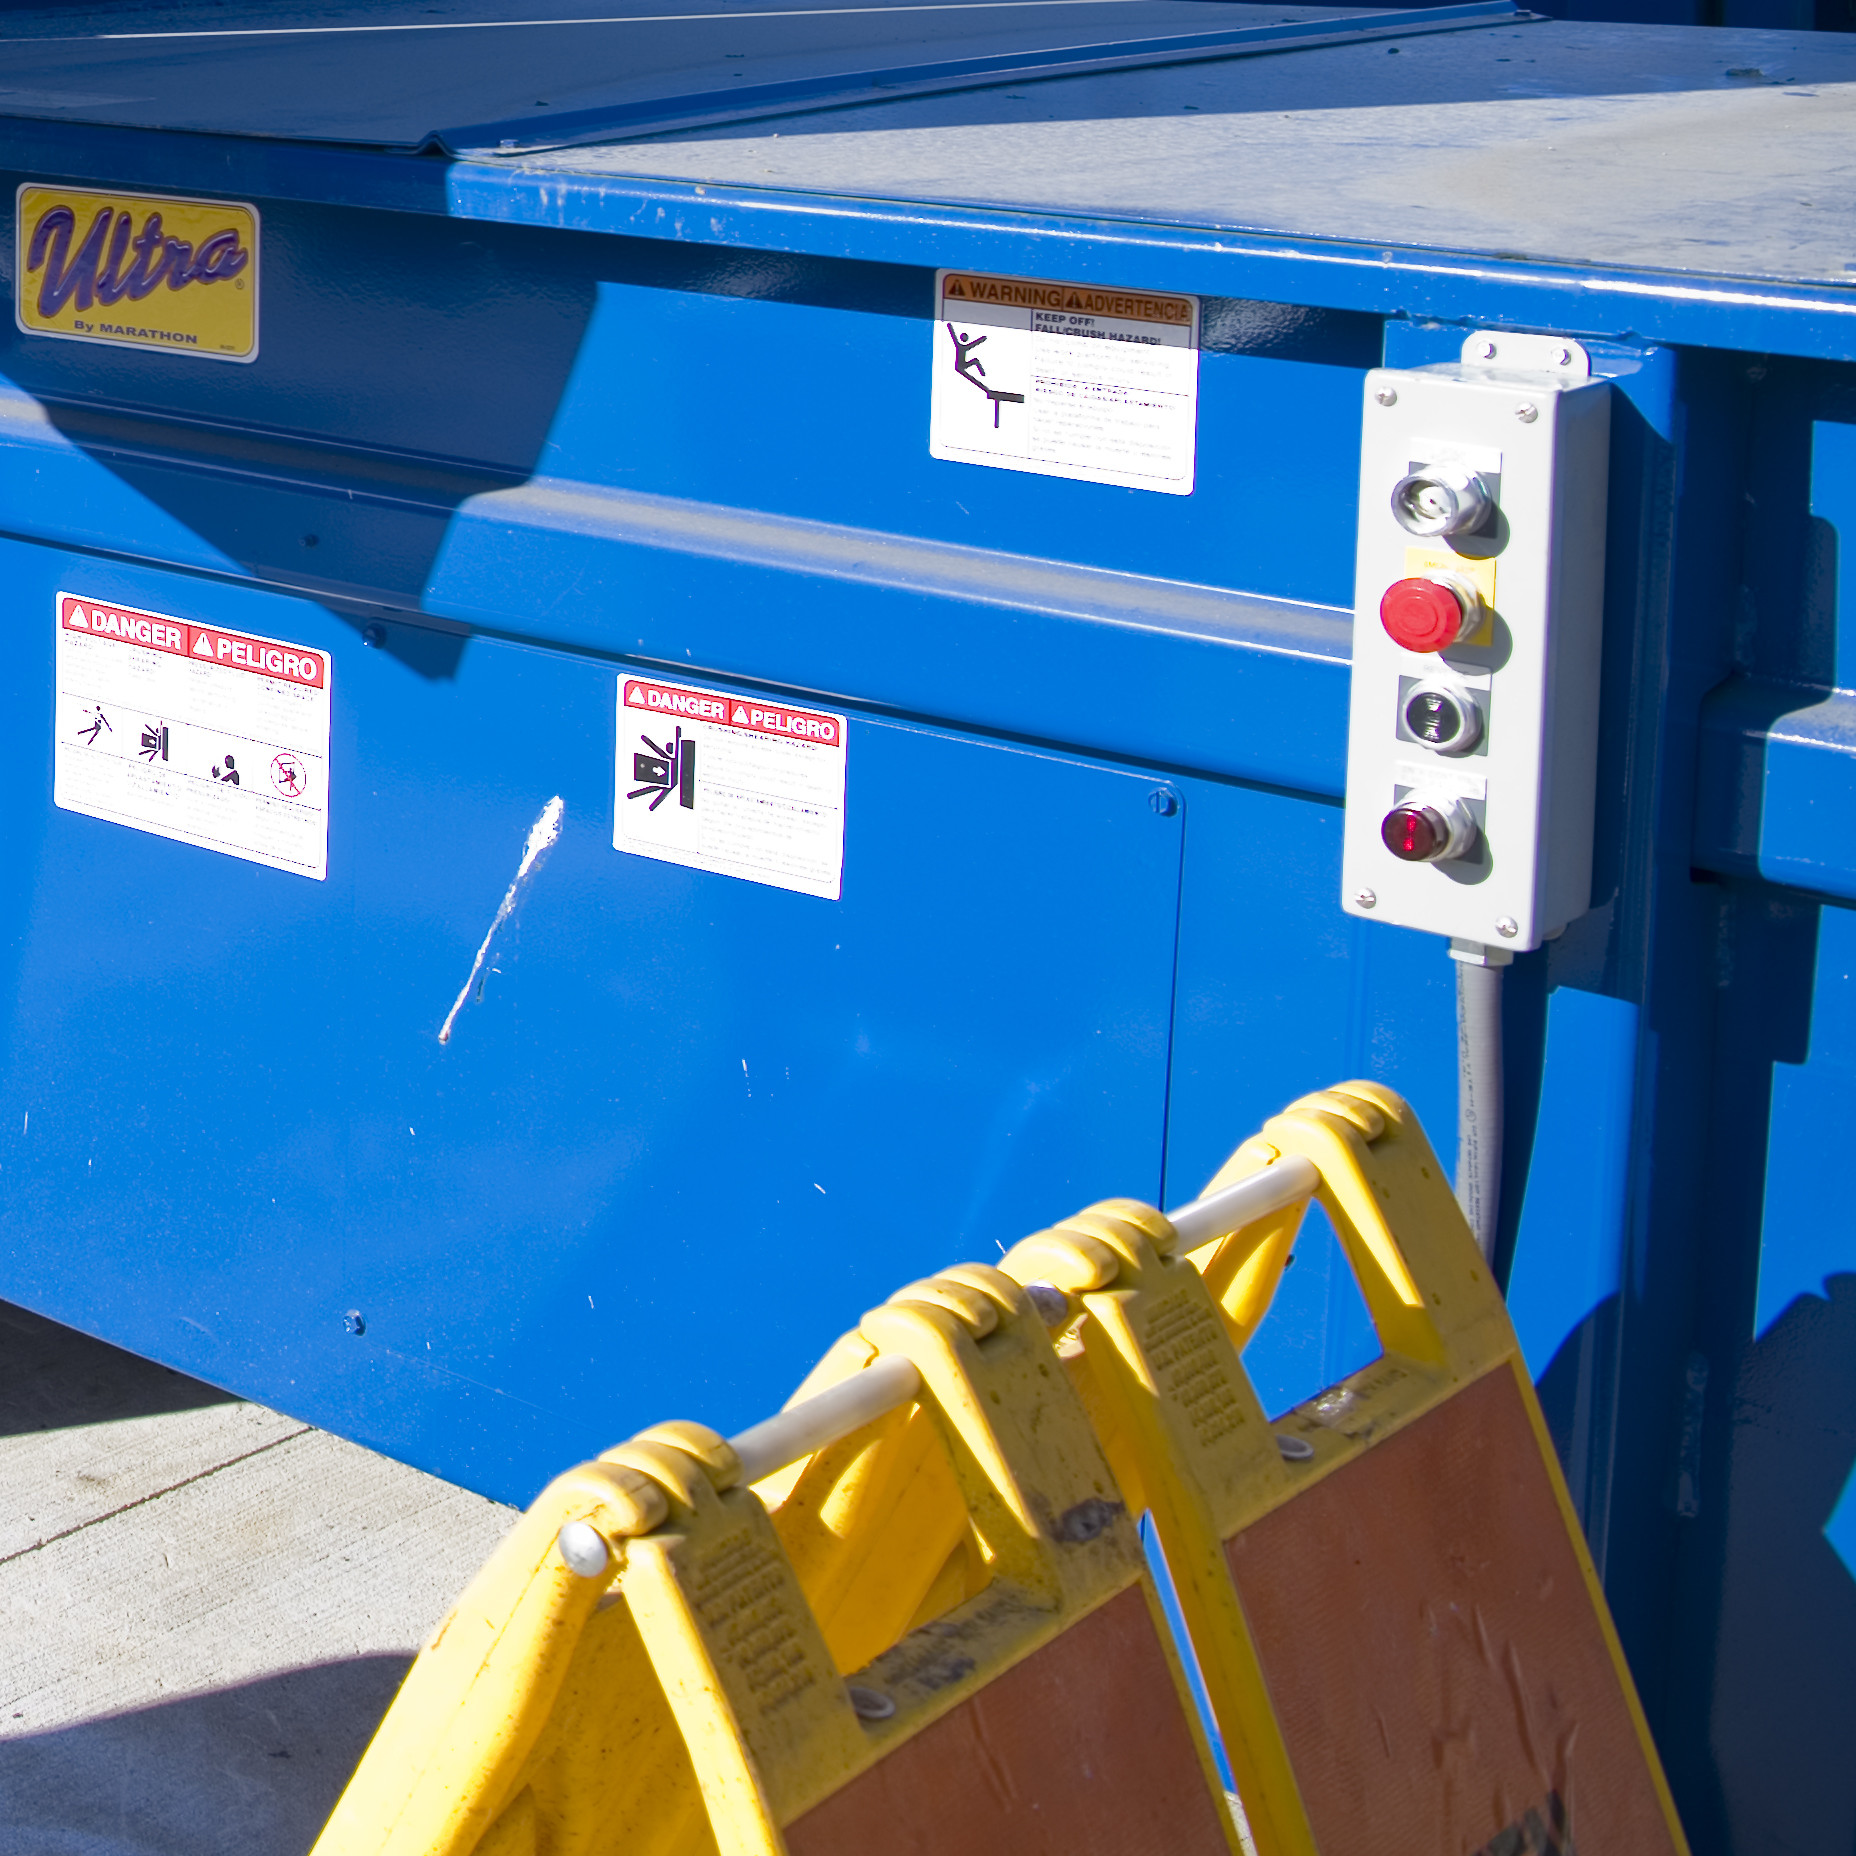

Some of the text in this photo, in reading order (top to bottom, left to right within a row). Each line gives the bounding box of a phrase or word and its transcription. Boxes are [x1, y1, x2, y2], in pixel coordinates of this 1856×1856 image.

[27, 204, 248, 318] Ultra
[970, 281, 1190, 321] WARNING ADVERTENCIA
[1035, 312, 1095, 326] KEEP OFF!
[74, 320, 198, 344] By MARATHON
[91, 609, 317, 681] DANGER PELIGRO
[647, 689, 835, 741] DANGER PELIGRO
